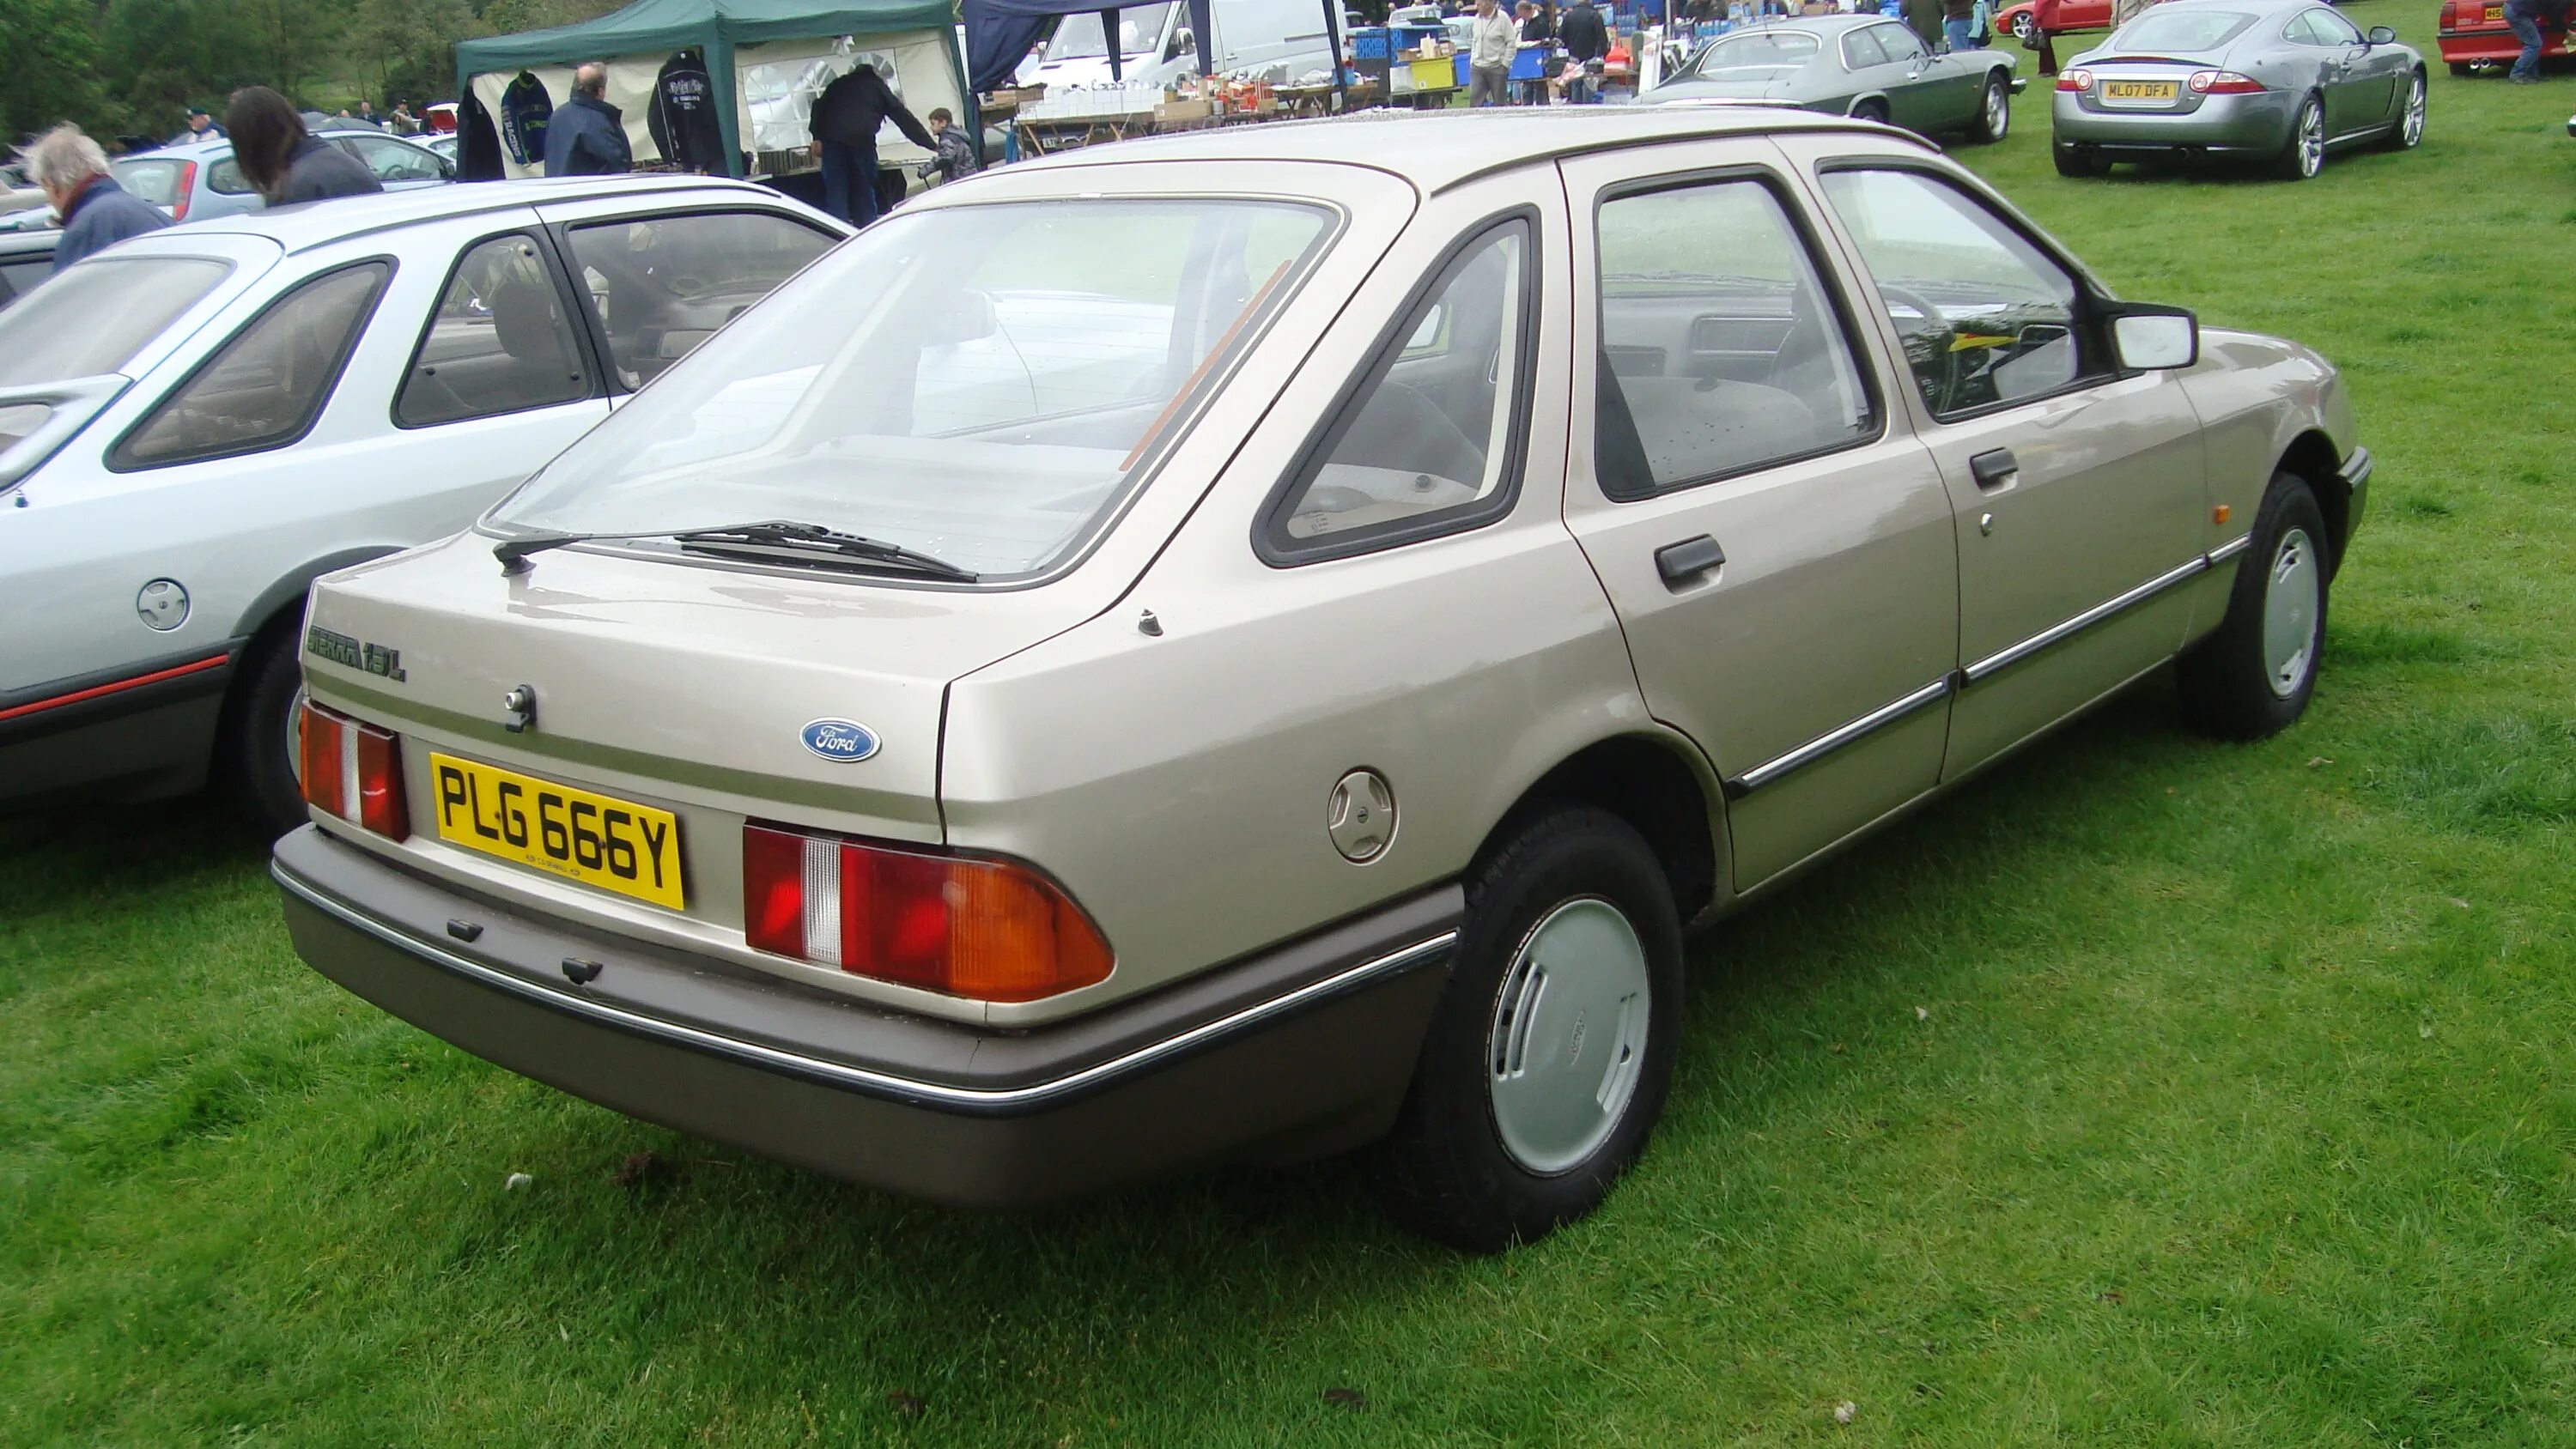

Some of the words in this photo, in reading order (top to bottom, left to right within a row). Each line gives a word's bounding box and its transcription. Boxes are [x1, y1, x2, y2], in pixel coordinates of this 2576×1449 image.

[2109, 84, 2142, 97] ML07
[2145, 84, 2169, 97] DFA
[504, 121, 521, 156] RACING
[307, 625, 363, 670] SIERRA
[816, 724, 859, 752] Ford
[440, 765, 528, 848] PLG
[538, 792, 666, 888] 666Y
